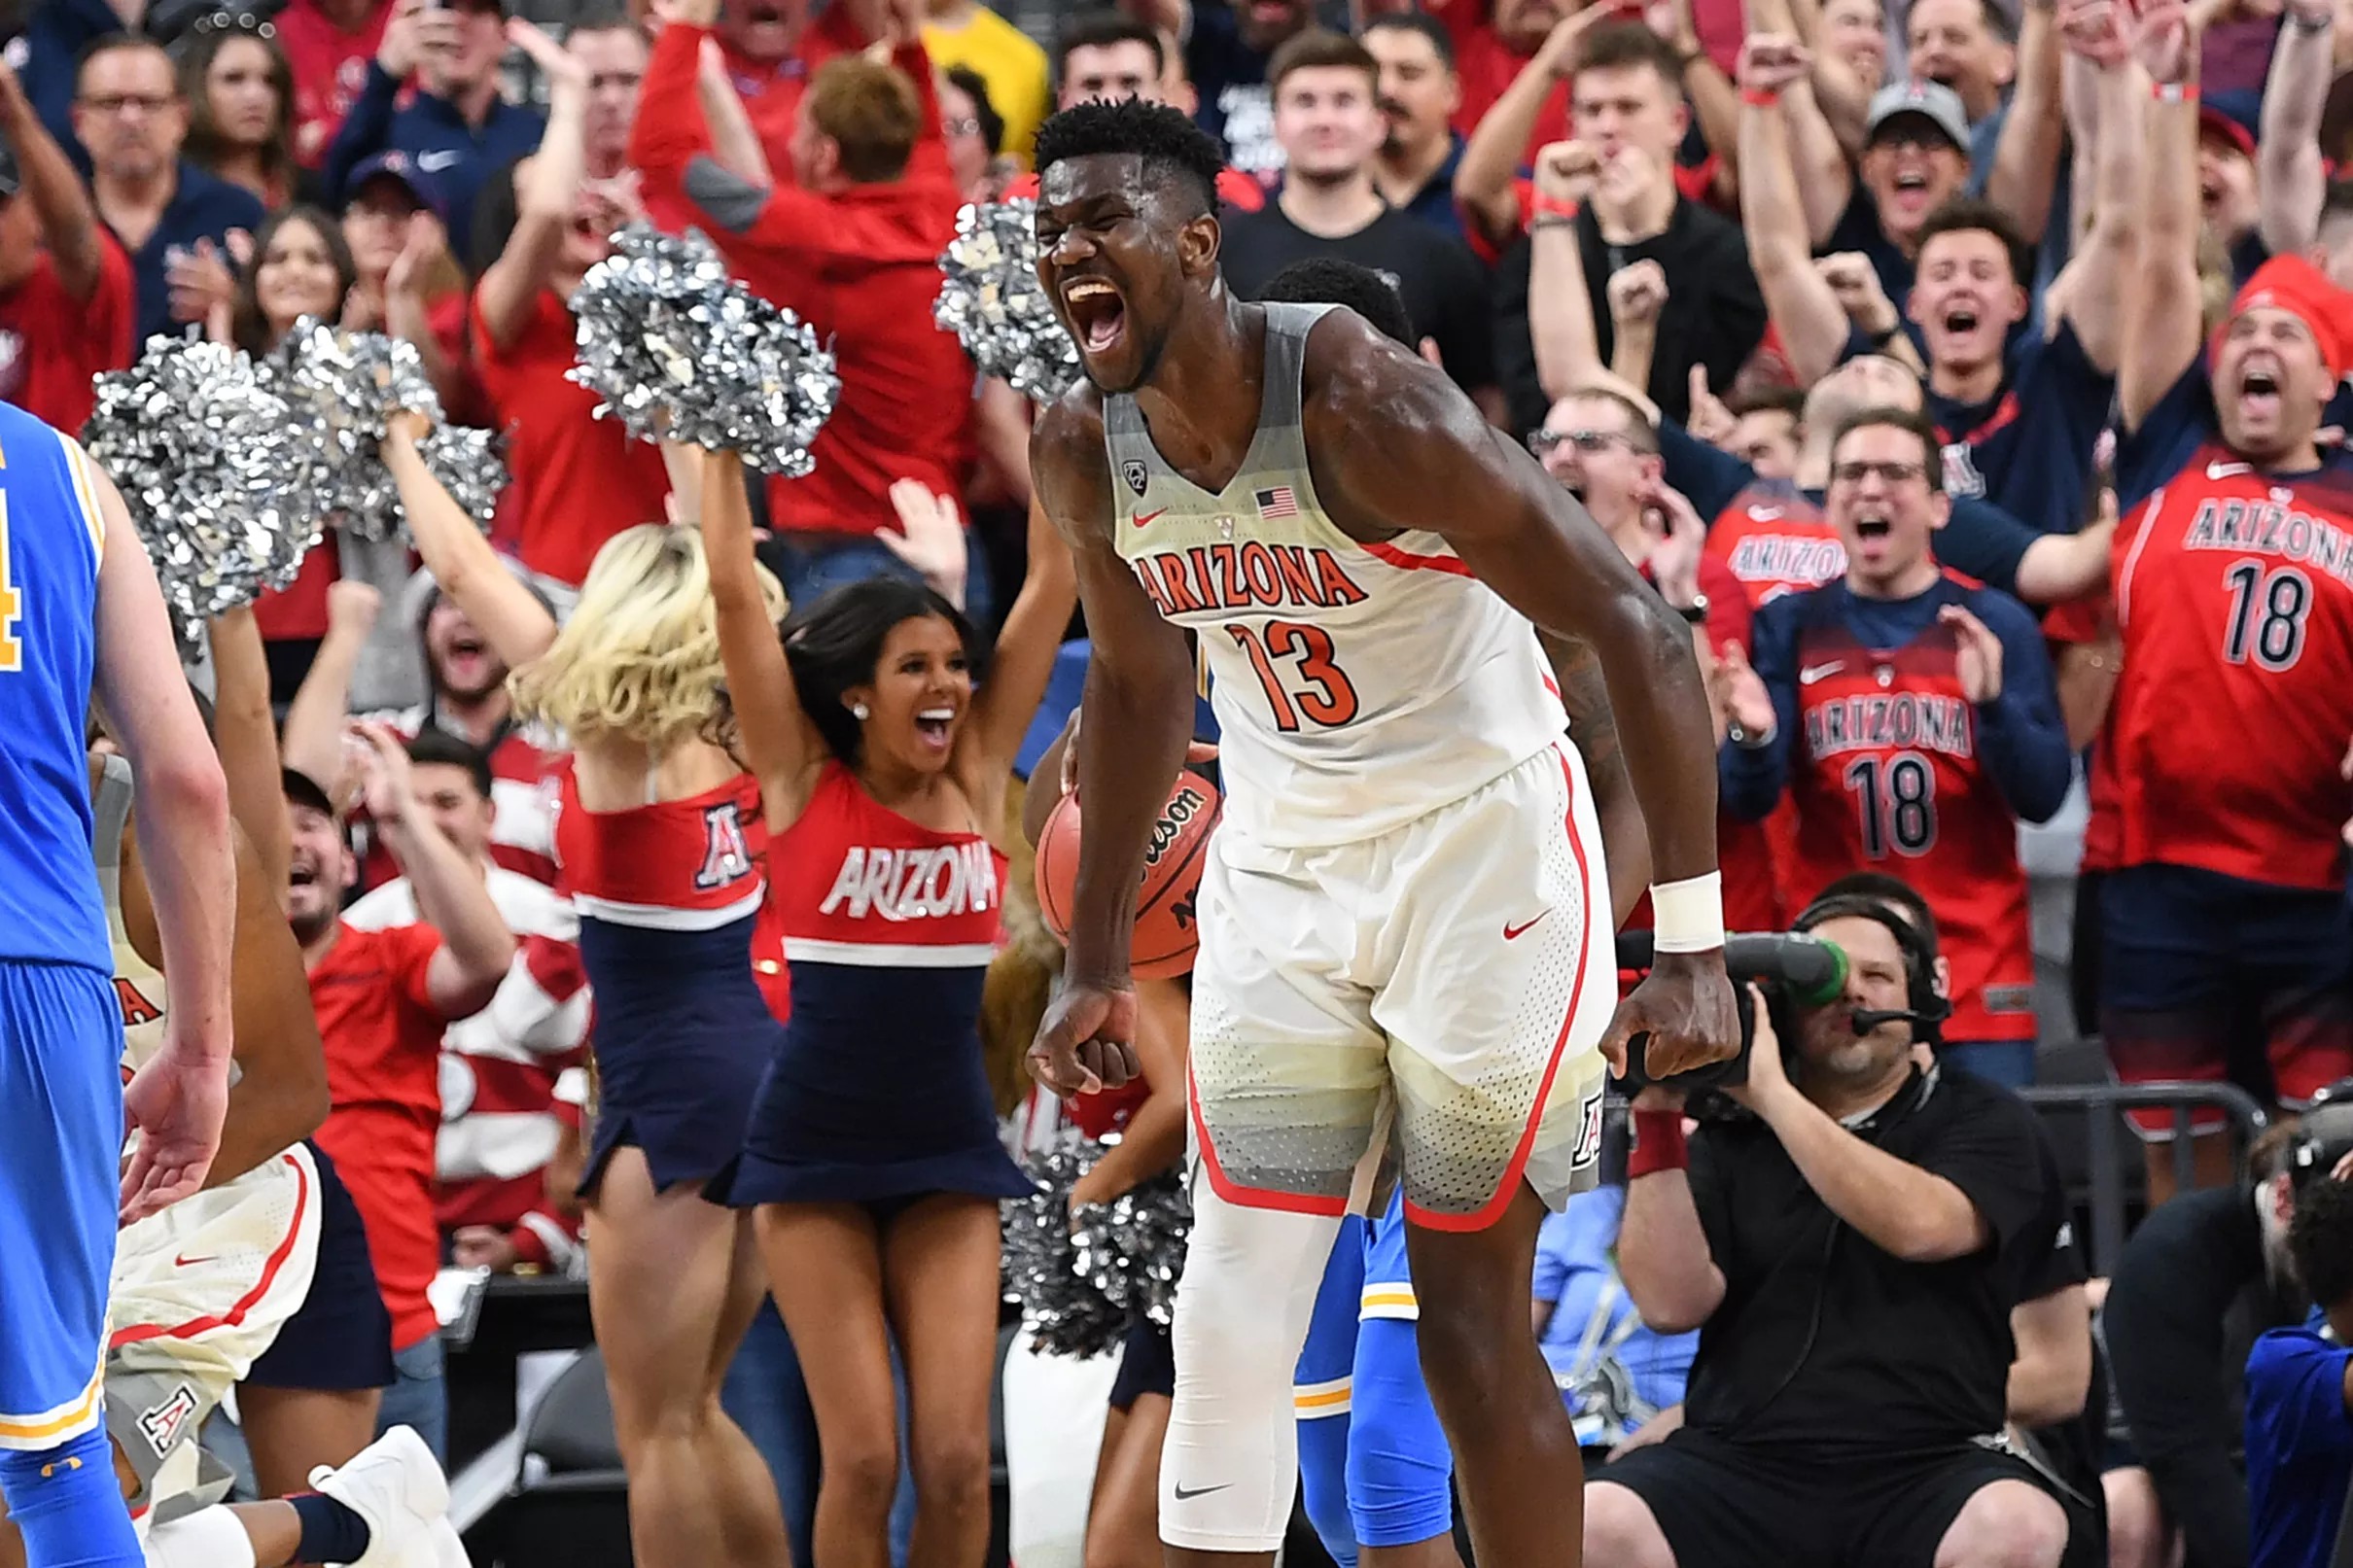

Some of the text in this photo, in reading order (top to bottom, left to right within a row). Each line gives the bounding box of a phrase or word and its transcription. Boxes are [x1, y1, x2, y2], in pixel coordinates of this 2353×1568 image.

[1134, 540, 1369, 616] ARIZONA
[2223, 557, 2313, 673] 18
[1224, 619, 1359, 732] 13
[1804, 691, 1974, 761] ARIZONA
[694, 800, 754, 890] A
[1844, 750, 1939, 861] 18
[819, 840, 998, 922] ARIZONA
[1570, 1088, 1603, 1170] A
[136, 1381, 200, 1460] A
